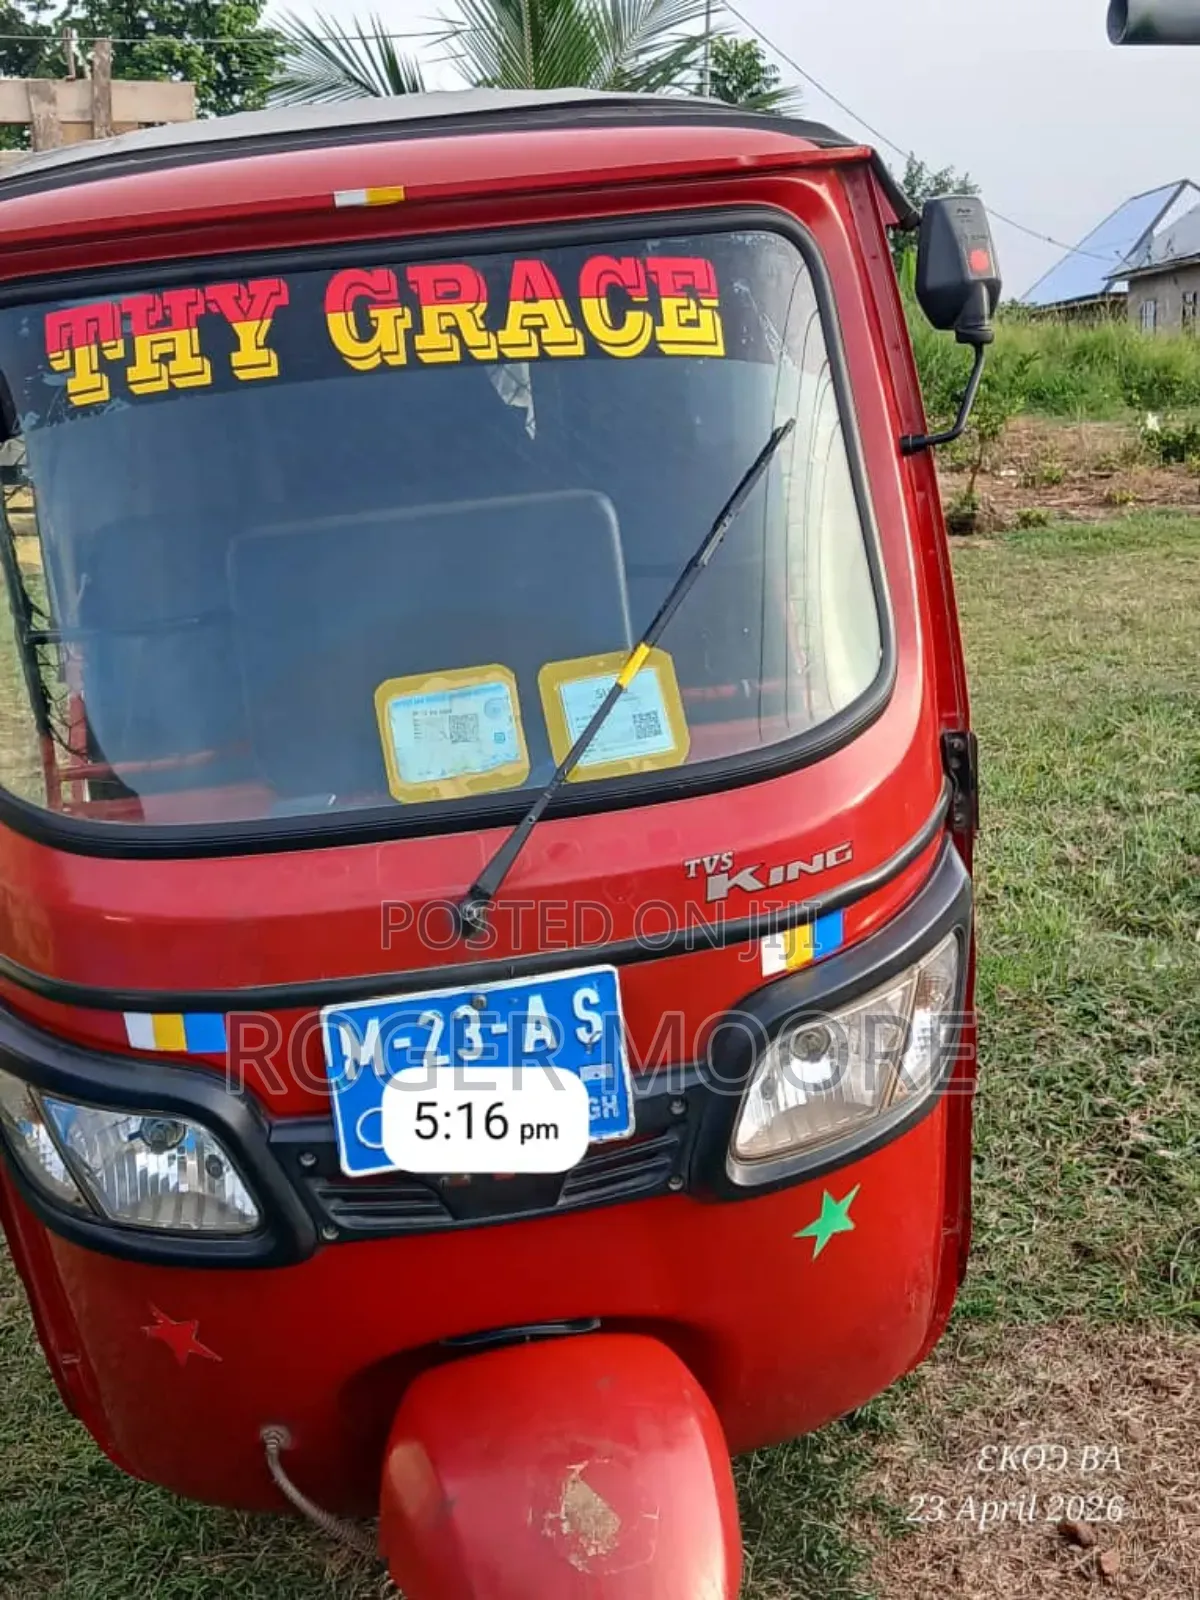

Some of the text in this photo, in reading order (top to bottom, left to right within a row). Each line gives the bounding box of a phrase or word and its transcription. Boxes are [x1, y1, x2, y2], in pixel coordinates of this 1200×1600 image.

[45, 255, 726, 407] THY GRACE
[684, 851, 735, 879] TVS
[706, 842, 853, 902] KING
